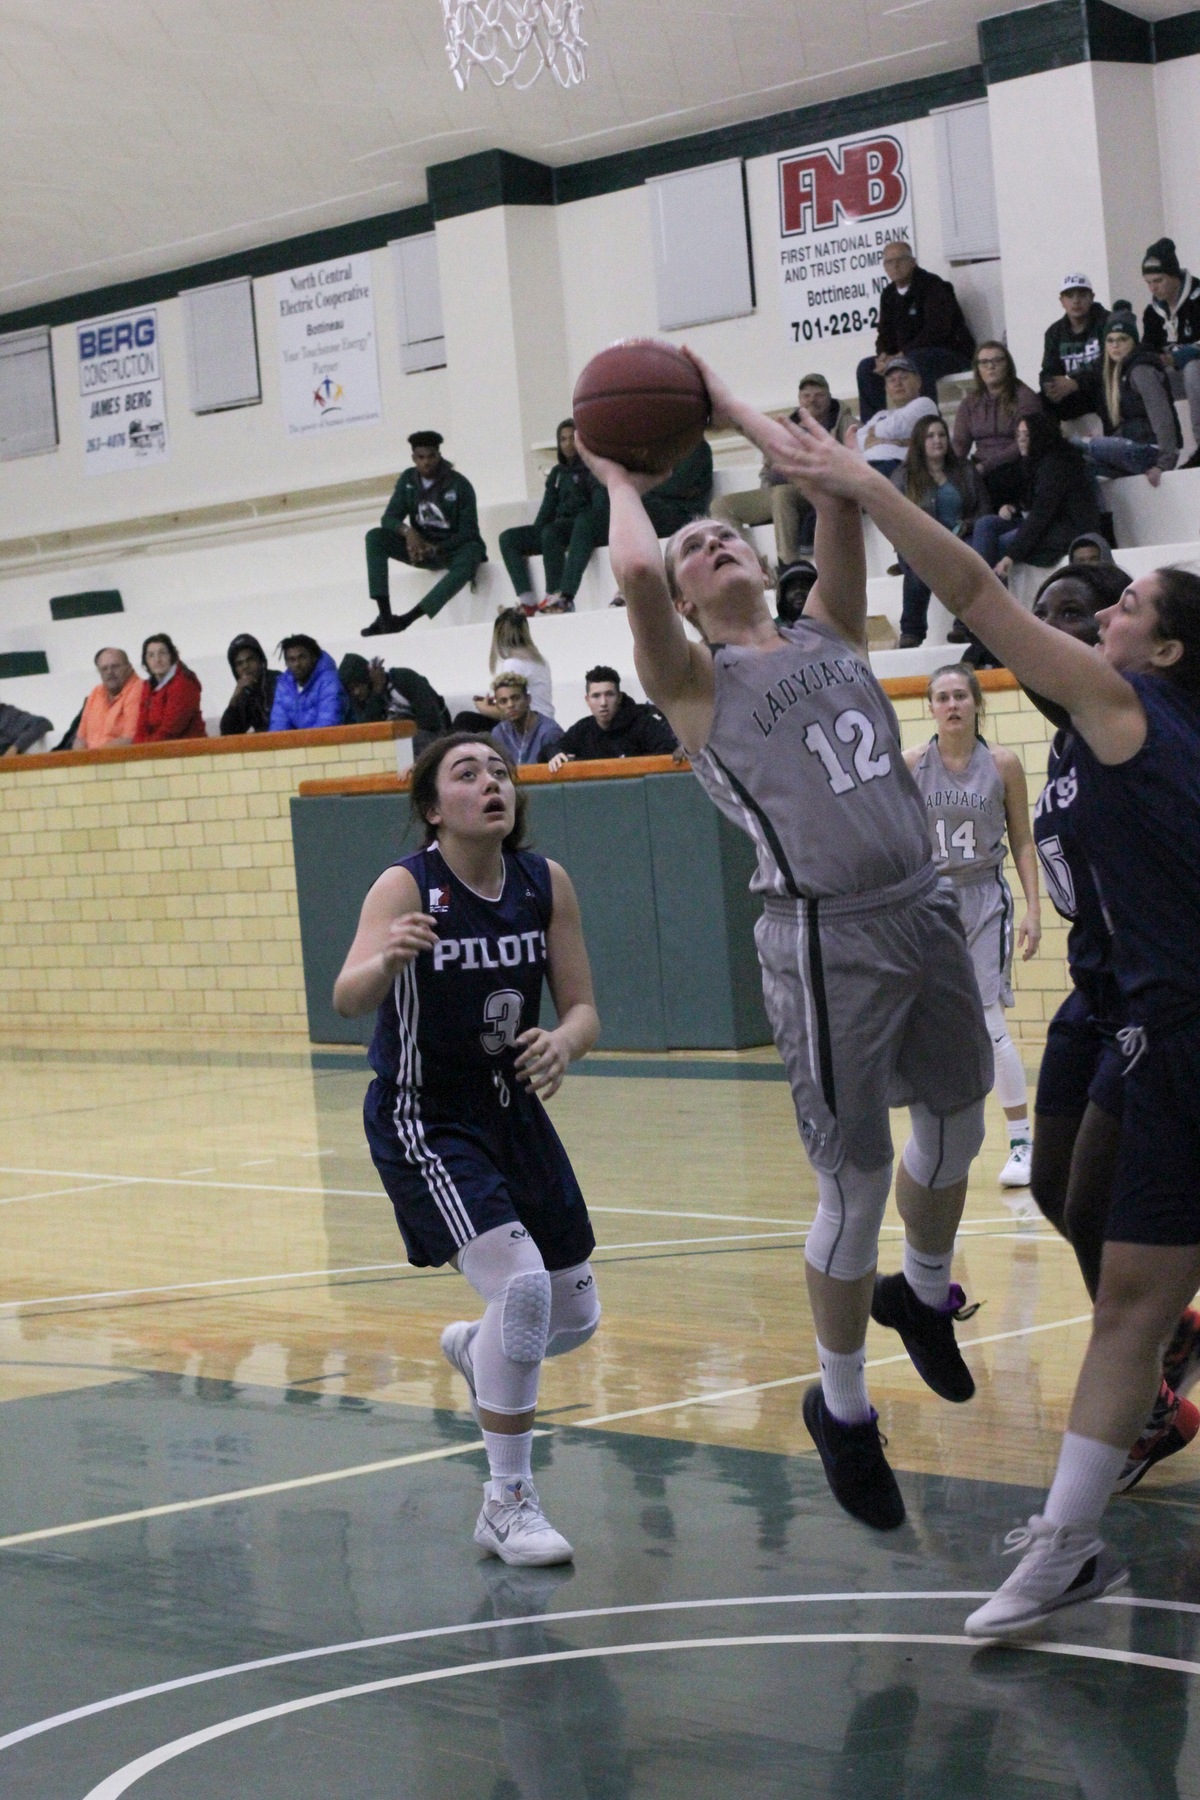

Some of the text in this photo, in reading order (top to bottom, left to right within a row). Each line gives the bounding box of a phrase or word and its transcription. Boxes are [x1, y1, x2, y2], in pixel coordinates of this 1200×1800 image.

[778, 135, 907, 238] FNB
[781, 226, 910, 265] FIRST NATIONAL BANK
[290, 262, 352, 291] North Central
[785, 251, 884, 283] AND TRUST COMP
[280, 283, 369, 317] Electric Cooperative
[808, 283, 869, 307] Bottineau,
[80, 318, 154, 360] BERG
[306, 320, 344, 336] Bottineau
[791, 306, 878, 342] 701-228-2
[84, 352, 154, 387] CONSTRUCTION
[90, 390, 151, 418] JAMES BERG
[802, 708, 891, 795] 12
[926, 790, 993, 815] ADYJACKS
[936, 819, 976, 859] 14
[480, 988, 525, 1056] 3
